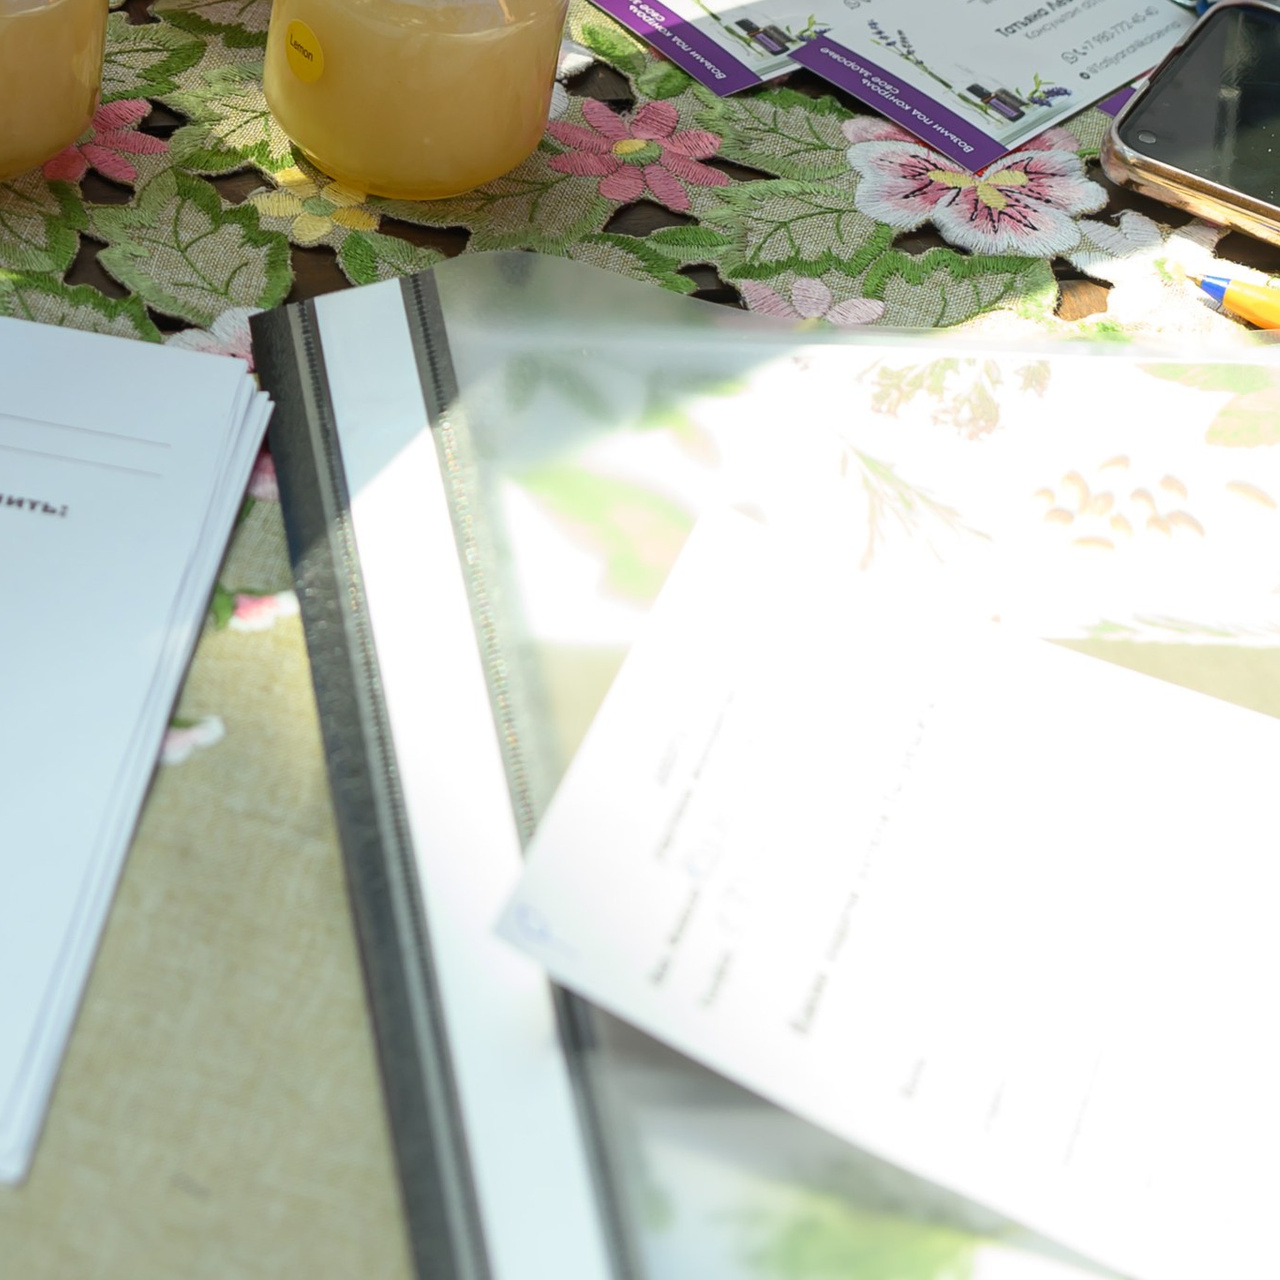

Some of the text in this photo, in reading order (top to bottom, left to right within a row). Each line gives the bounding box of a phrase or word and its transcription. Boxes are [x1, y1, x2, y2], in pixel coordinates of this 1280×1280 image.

[640, 4, 665, 22] свое
[995, 7, 1048, 38] Татьяна
[290, 33, 313, 62] Lemon
[629, 5, 726, 80] Возьми под контроль
[820, 47, 900, 95] свое здоровье
[862, 78, 974, 153] Возьми под контроль
